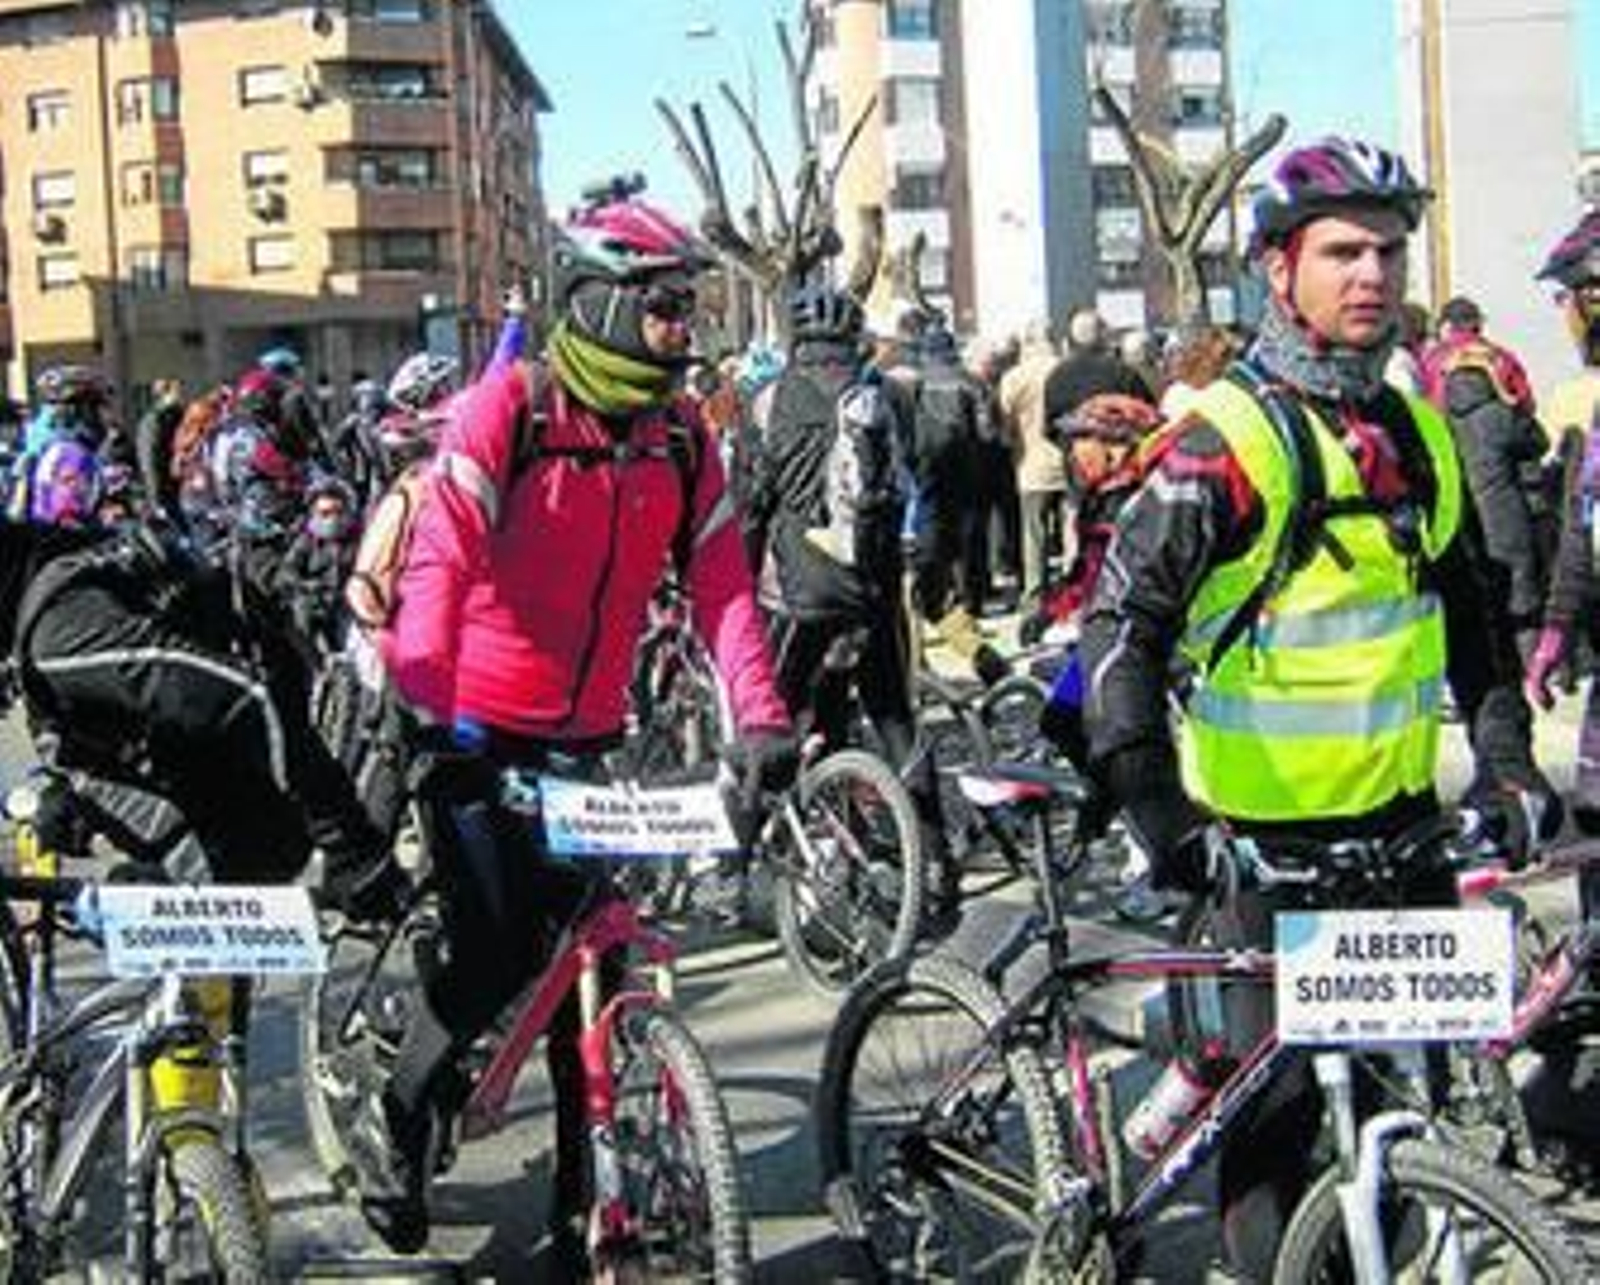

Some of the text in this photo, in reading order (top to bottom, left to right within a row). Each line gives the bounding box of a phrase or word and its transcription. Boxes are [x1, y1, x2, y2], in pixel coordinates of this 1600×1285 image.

[152, 898, 263, 919] ALBERTO
[120, 926, 305, 948] SOMOS TODOS
[1334, 933, 1458, 960] ALBERTO
[1296, 973, 1498, 1003] SOMOS TODOS
